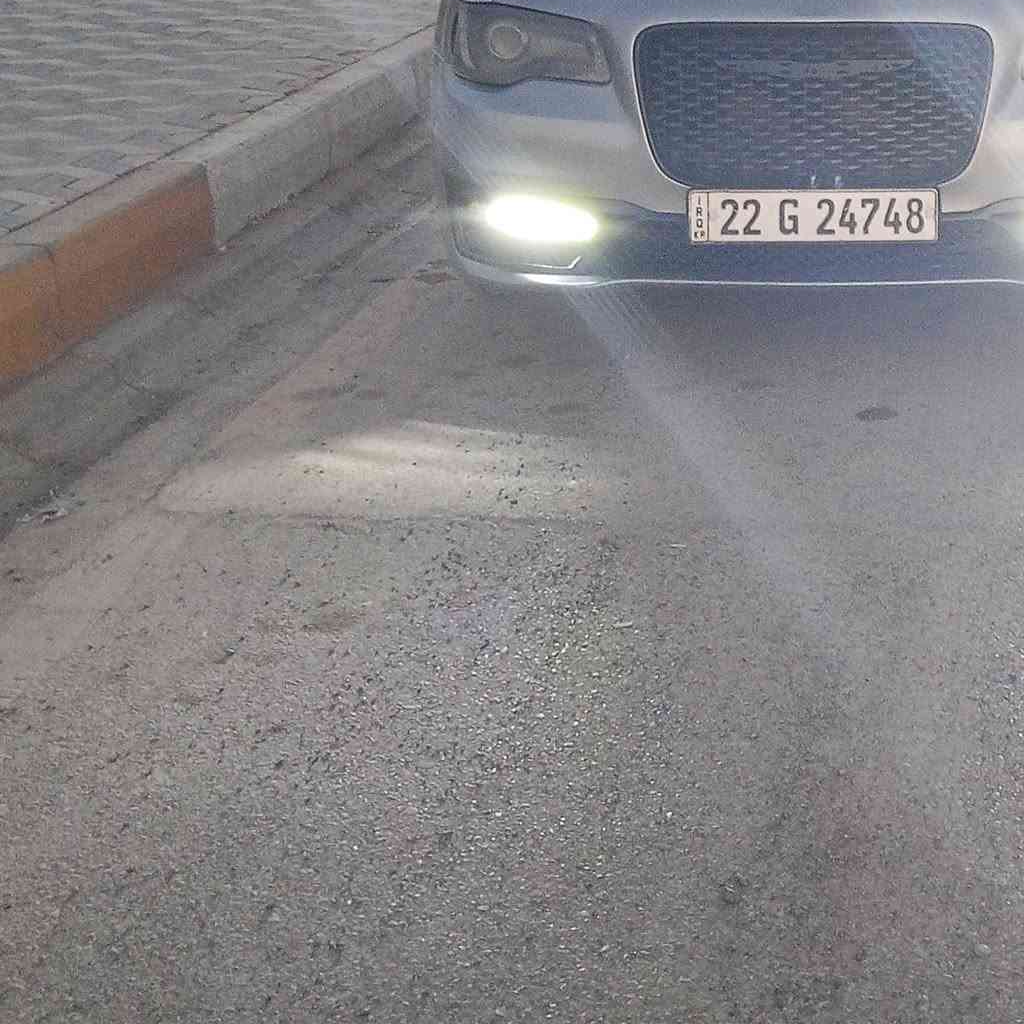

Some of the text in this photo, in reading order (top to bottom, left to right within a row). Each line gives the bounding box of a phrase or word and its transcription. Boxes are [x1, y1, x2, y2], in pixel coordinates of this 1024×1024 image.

[720, 197, 925, 236] 22 G 24748
